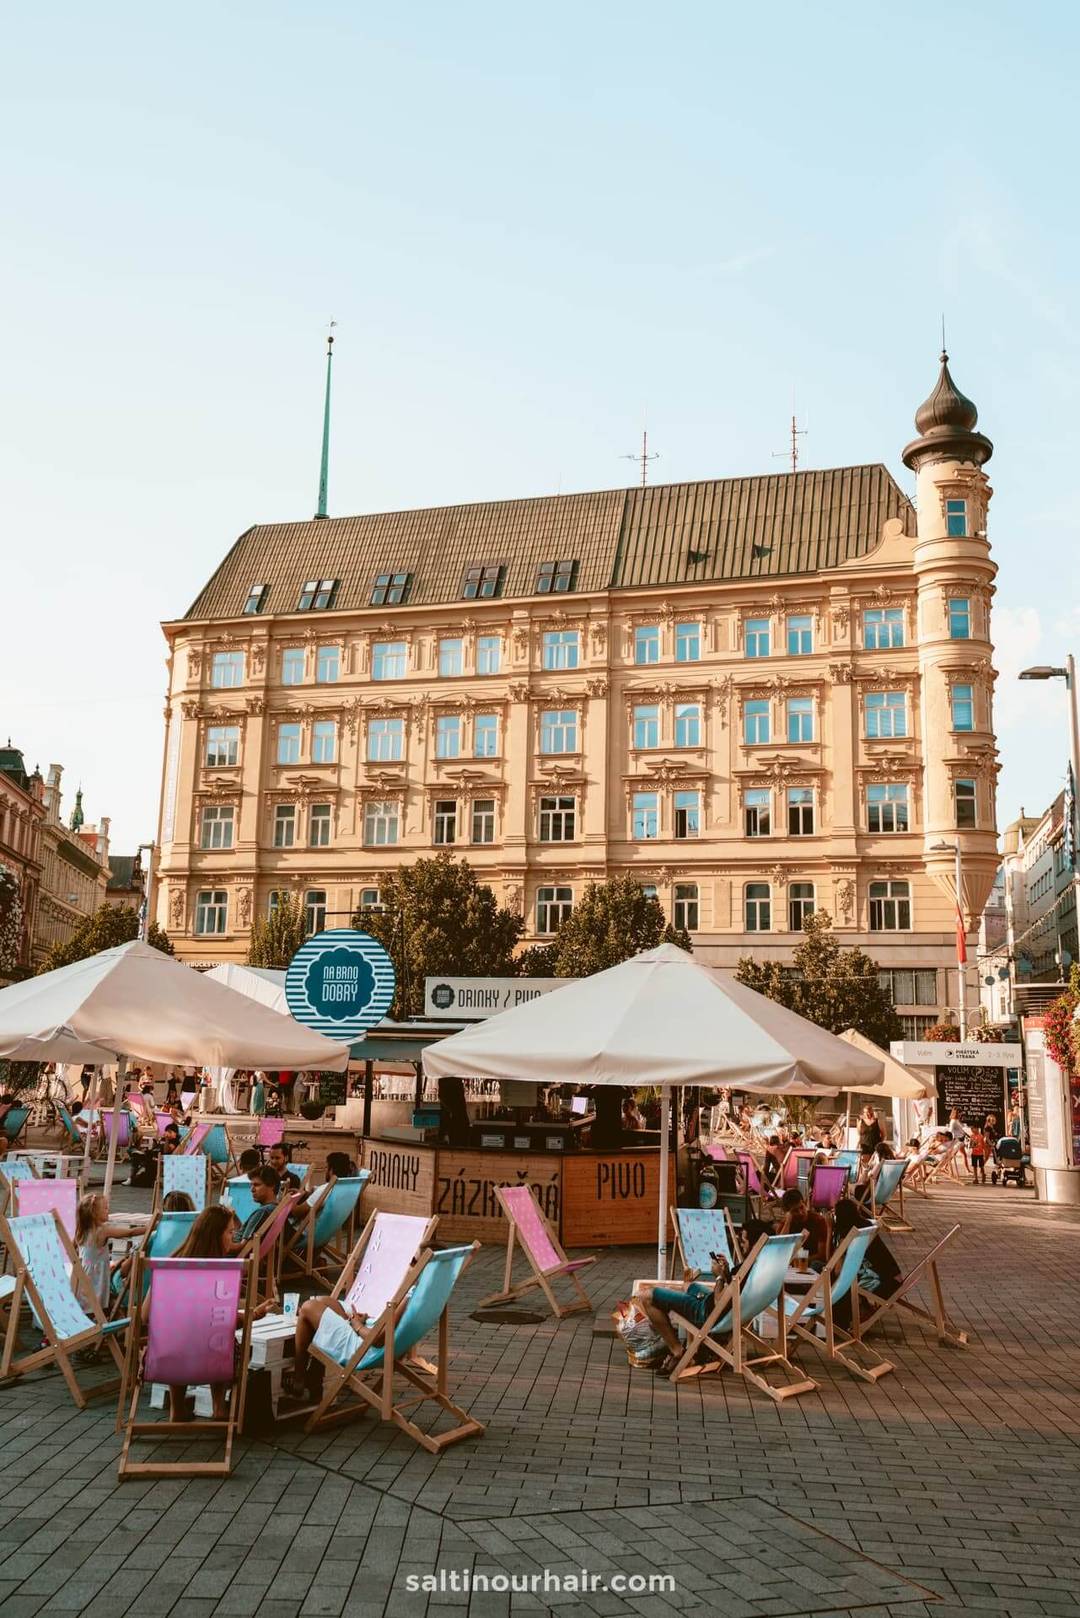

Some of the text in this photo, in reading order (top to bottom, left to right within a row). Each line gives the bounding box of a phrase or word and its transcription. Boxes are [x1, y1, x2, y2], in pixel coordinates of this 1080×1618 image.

[323, 966, 358, 979] NA BRNO
[322, 980, 358, 1002] DOBRÝ
[458, 989, 500, 1008] DRINKY
[369, 1150, 419, 1191] DRINKY
[597, 1163, 646, 1200] PIVO
[438, 1167, 559, 1222] ZÁZRNÁ
